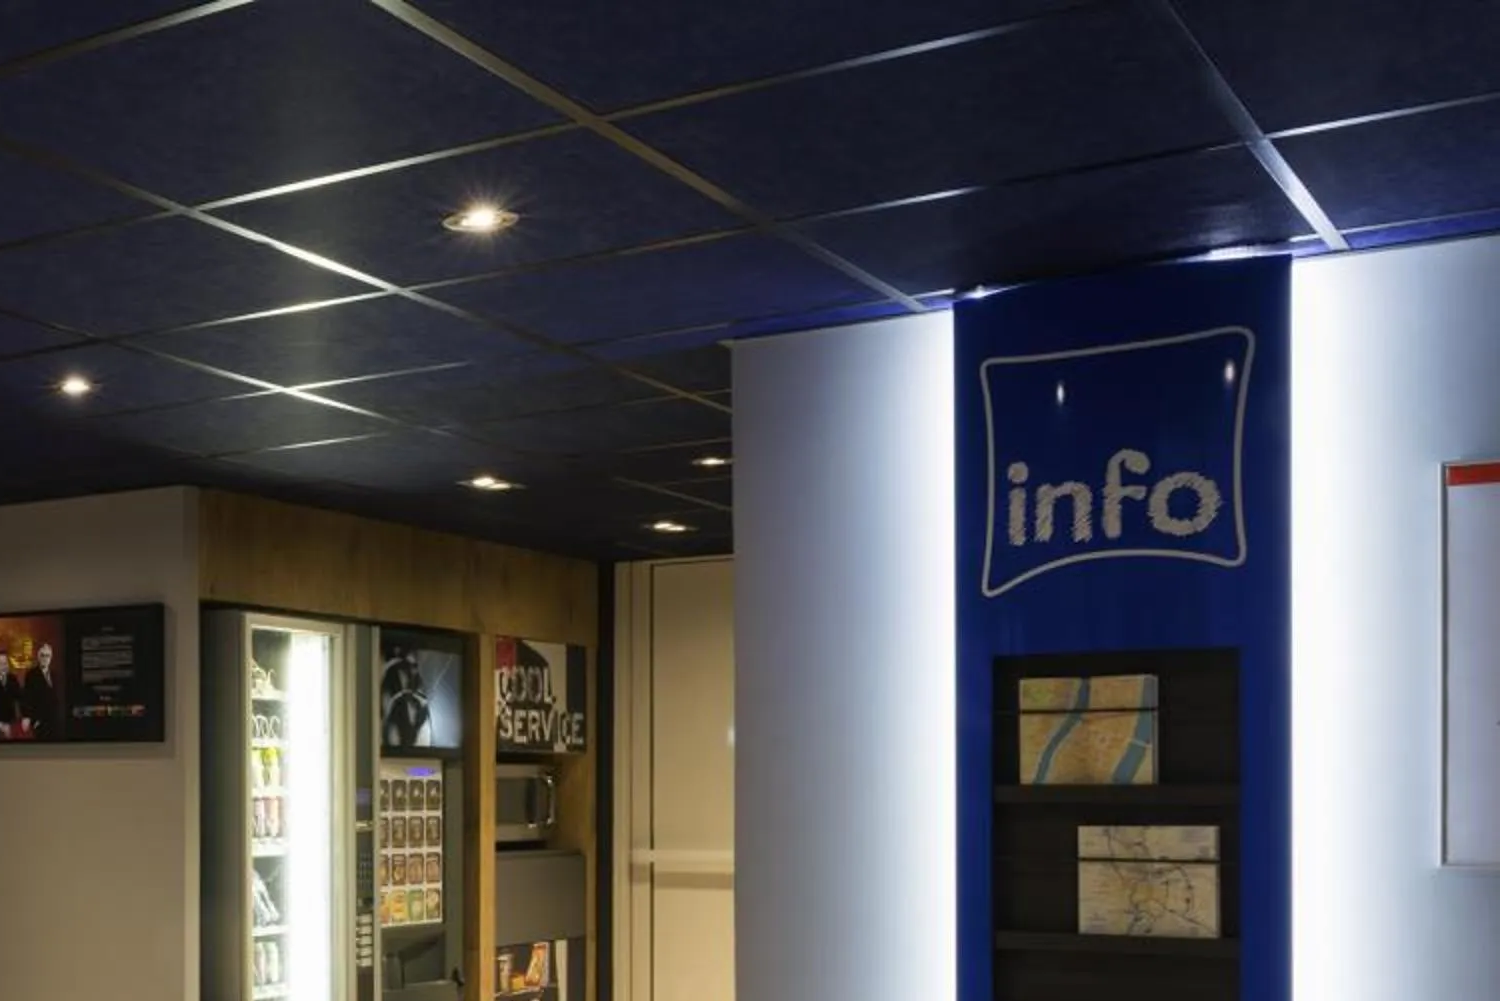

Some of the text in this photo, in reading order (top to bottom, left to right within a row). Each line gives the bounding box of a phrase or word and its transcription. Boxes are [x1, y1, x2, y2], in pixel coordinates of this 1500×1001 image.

[1007, 448, 1221, 545] info
[495, 666, 553, 704] COOL
[498, 705, 584, 744] SERVICE
